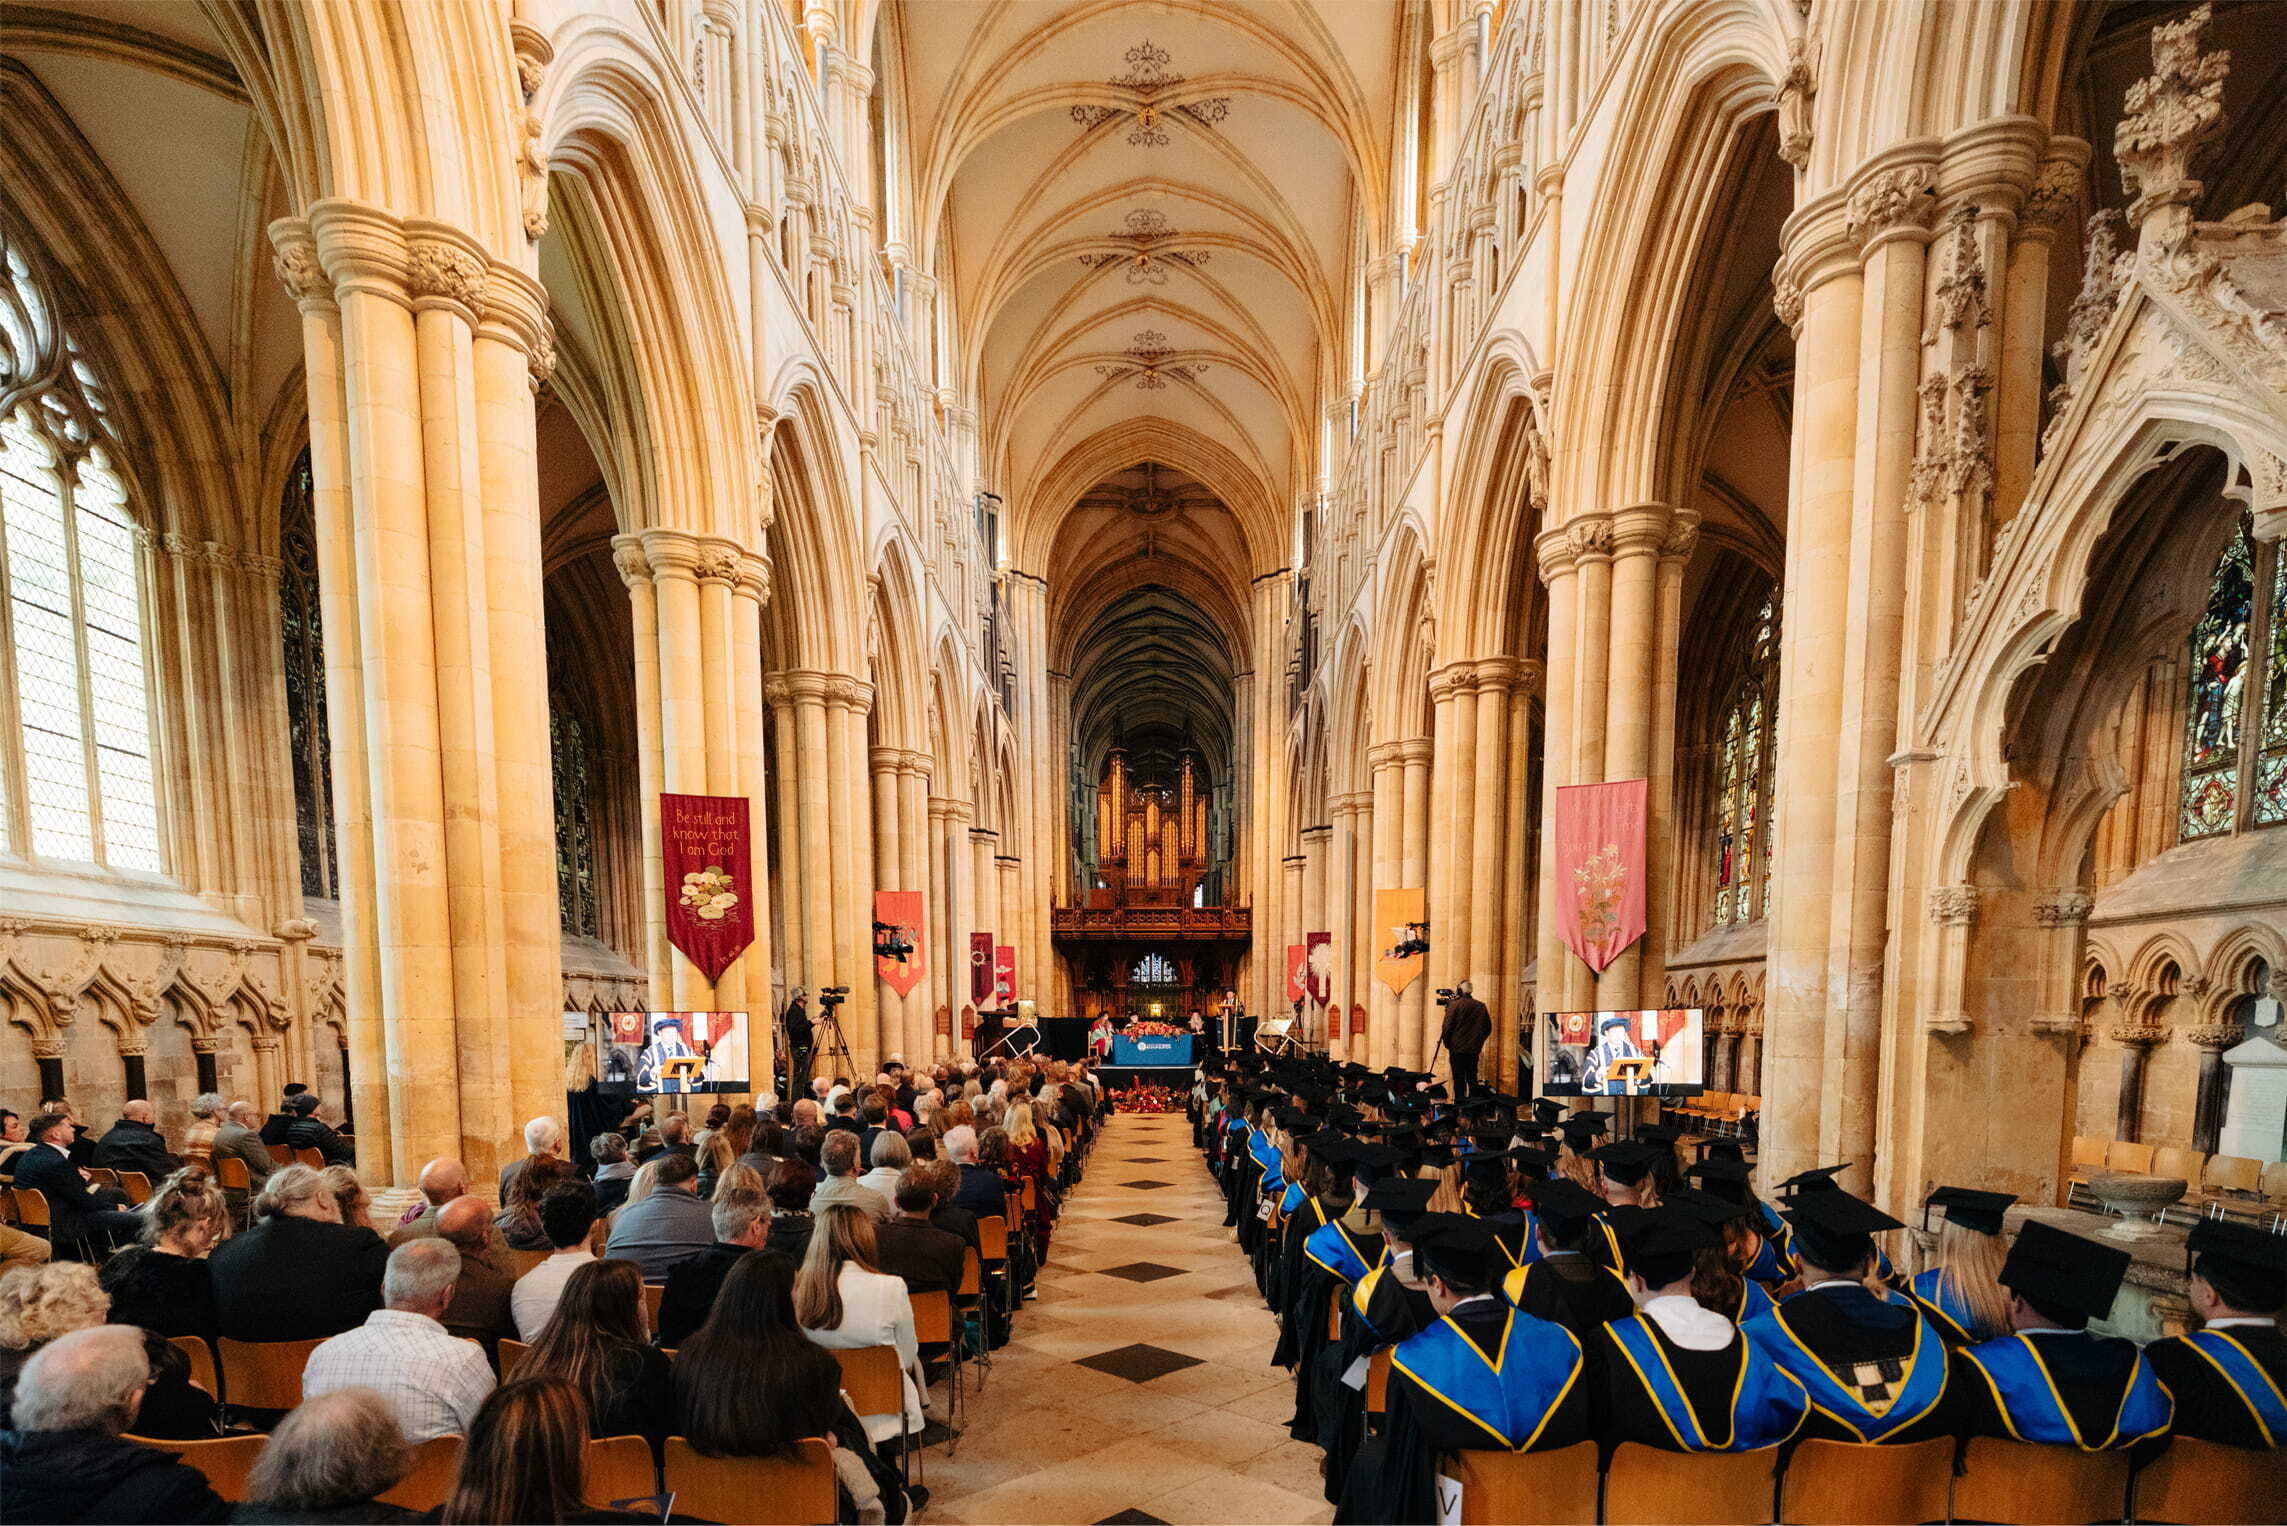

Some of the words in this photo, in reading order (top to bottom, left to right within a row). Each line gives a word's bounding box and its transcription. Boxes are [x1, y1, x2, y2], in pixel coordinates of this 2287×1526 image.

[676, 808, 690, 824] Be
[694, 808, 712, 825] still
[714, 811, 735, 825] and
[672, 825, 709, 840] know
[712, 827, 740, 841] that
[687, 846, 706, 856] am
[708, 841, 734, 856] God
[1261, 1205, 1271, 1216] Q
[1438, 1486, 1457, 1516] V
